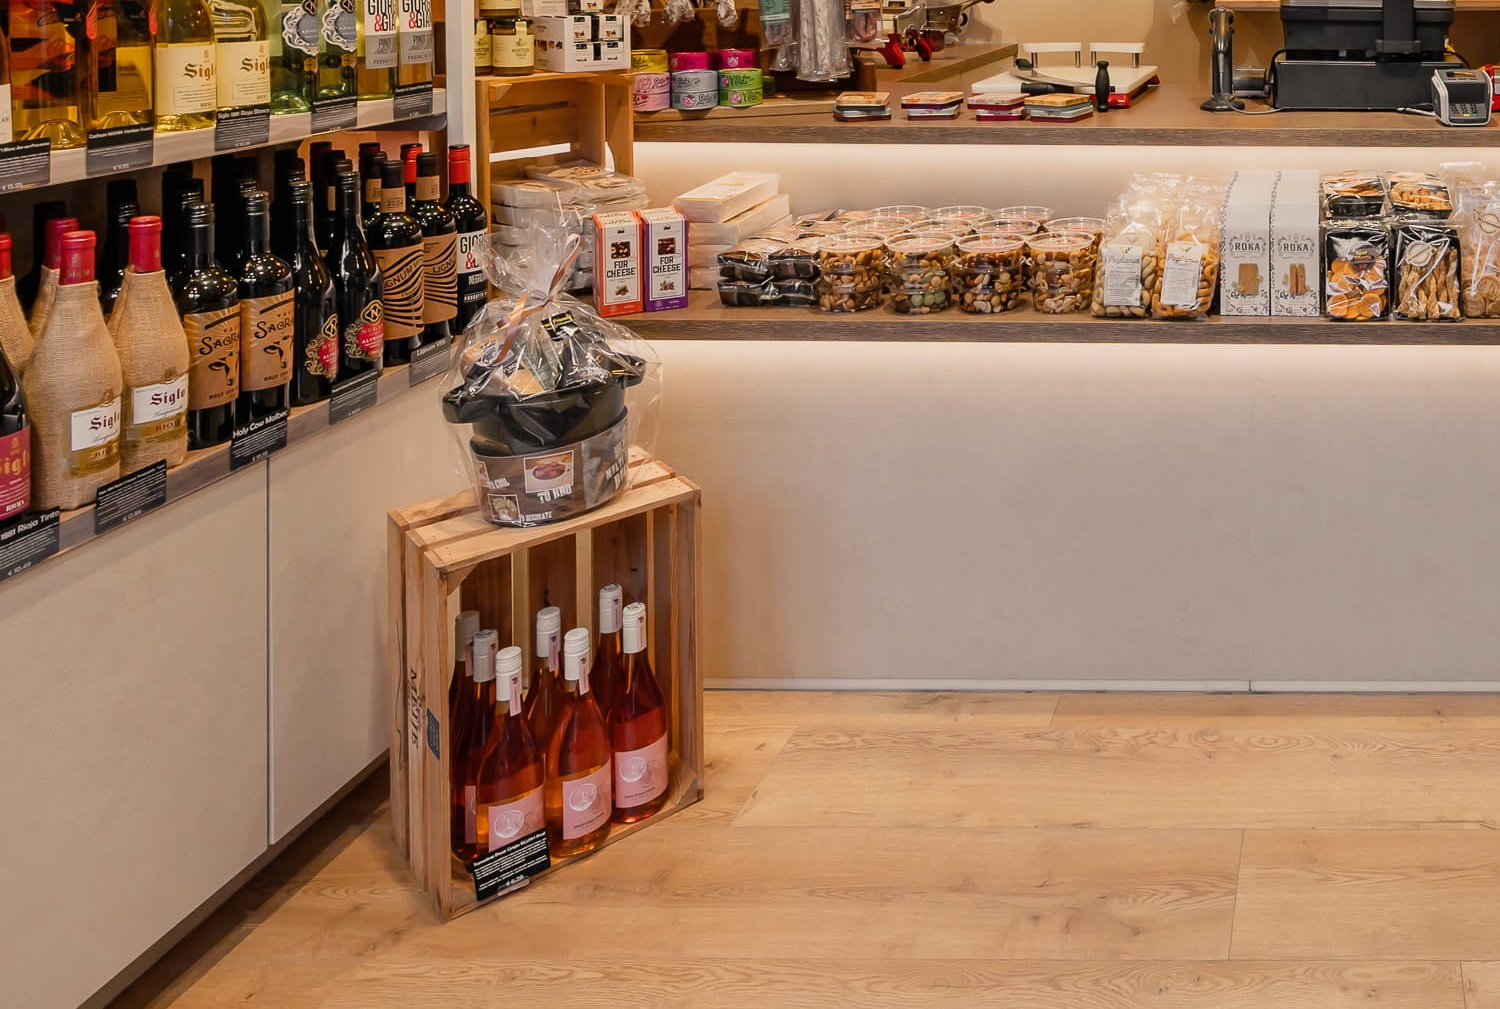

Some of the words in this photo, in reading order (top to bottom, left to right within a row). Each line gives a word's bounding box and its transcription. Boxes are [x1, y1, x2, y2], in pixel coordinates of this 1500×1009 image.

[1234, 241, 1261, 253] ROKA
[1283, 242, 1310, 253] ROKA
[613, 259, 629, 269] FOR
[659, 255, 674, 265] FOR
[606, 267, 637, 279] CHEESE
[652, 263, 682, 274] CHEESE
[149, 387, 186, 406] Siglo
[232, 423, 249, 440] Holy
[249, 418, 265, 431] Cow
[17, 519, 39, 536] Rioja
